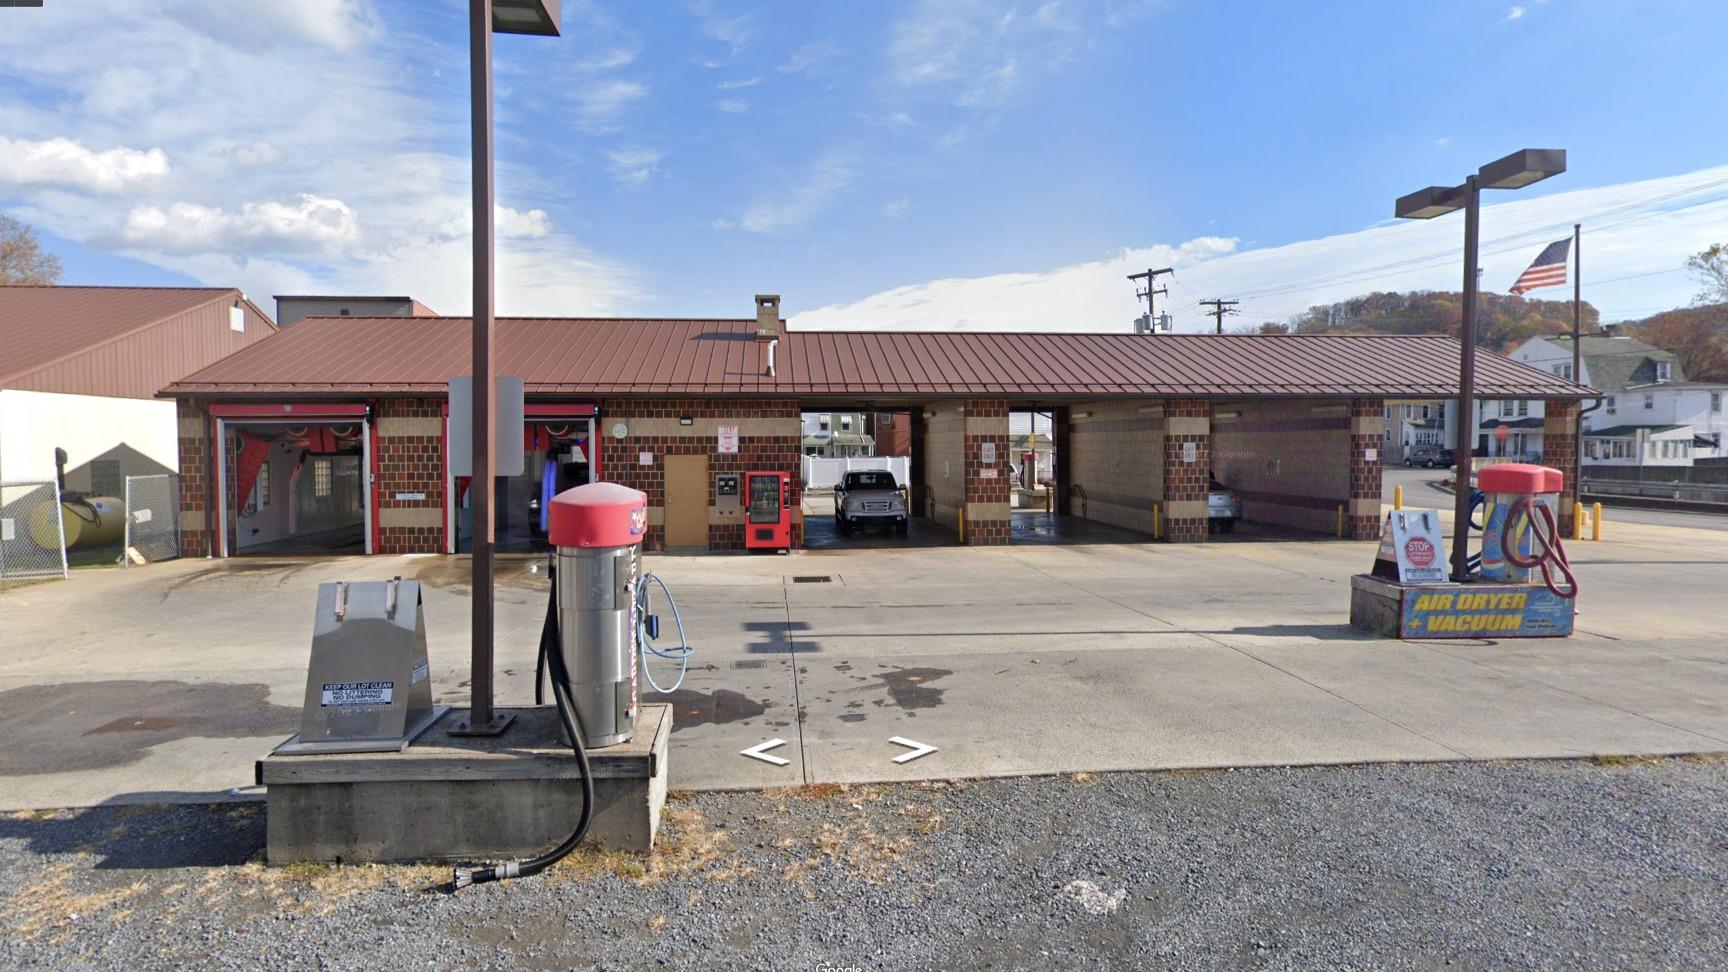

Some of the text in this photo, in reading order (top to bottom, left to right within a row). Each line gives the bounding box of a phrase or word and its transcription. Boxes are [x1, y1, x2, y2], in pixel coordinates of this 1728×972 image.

[1408, 541, 1430, 552] STOP
[1414, 593, 1454, 611] AIR
[1455, 592, 1528, 610] DRYER
[1427, 613, 1523, 632] VACUUM
